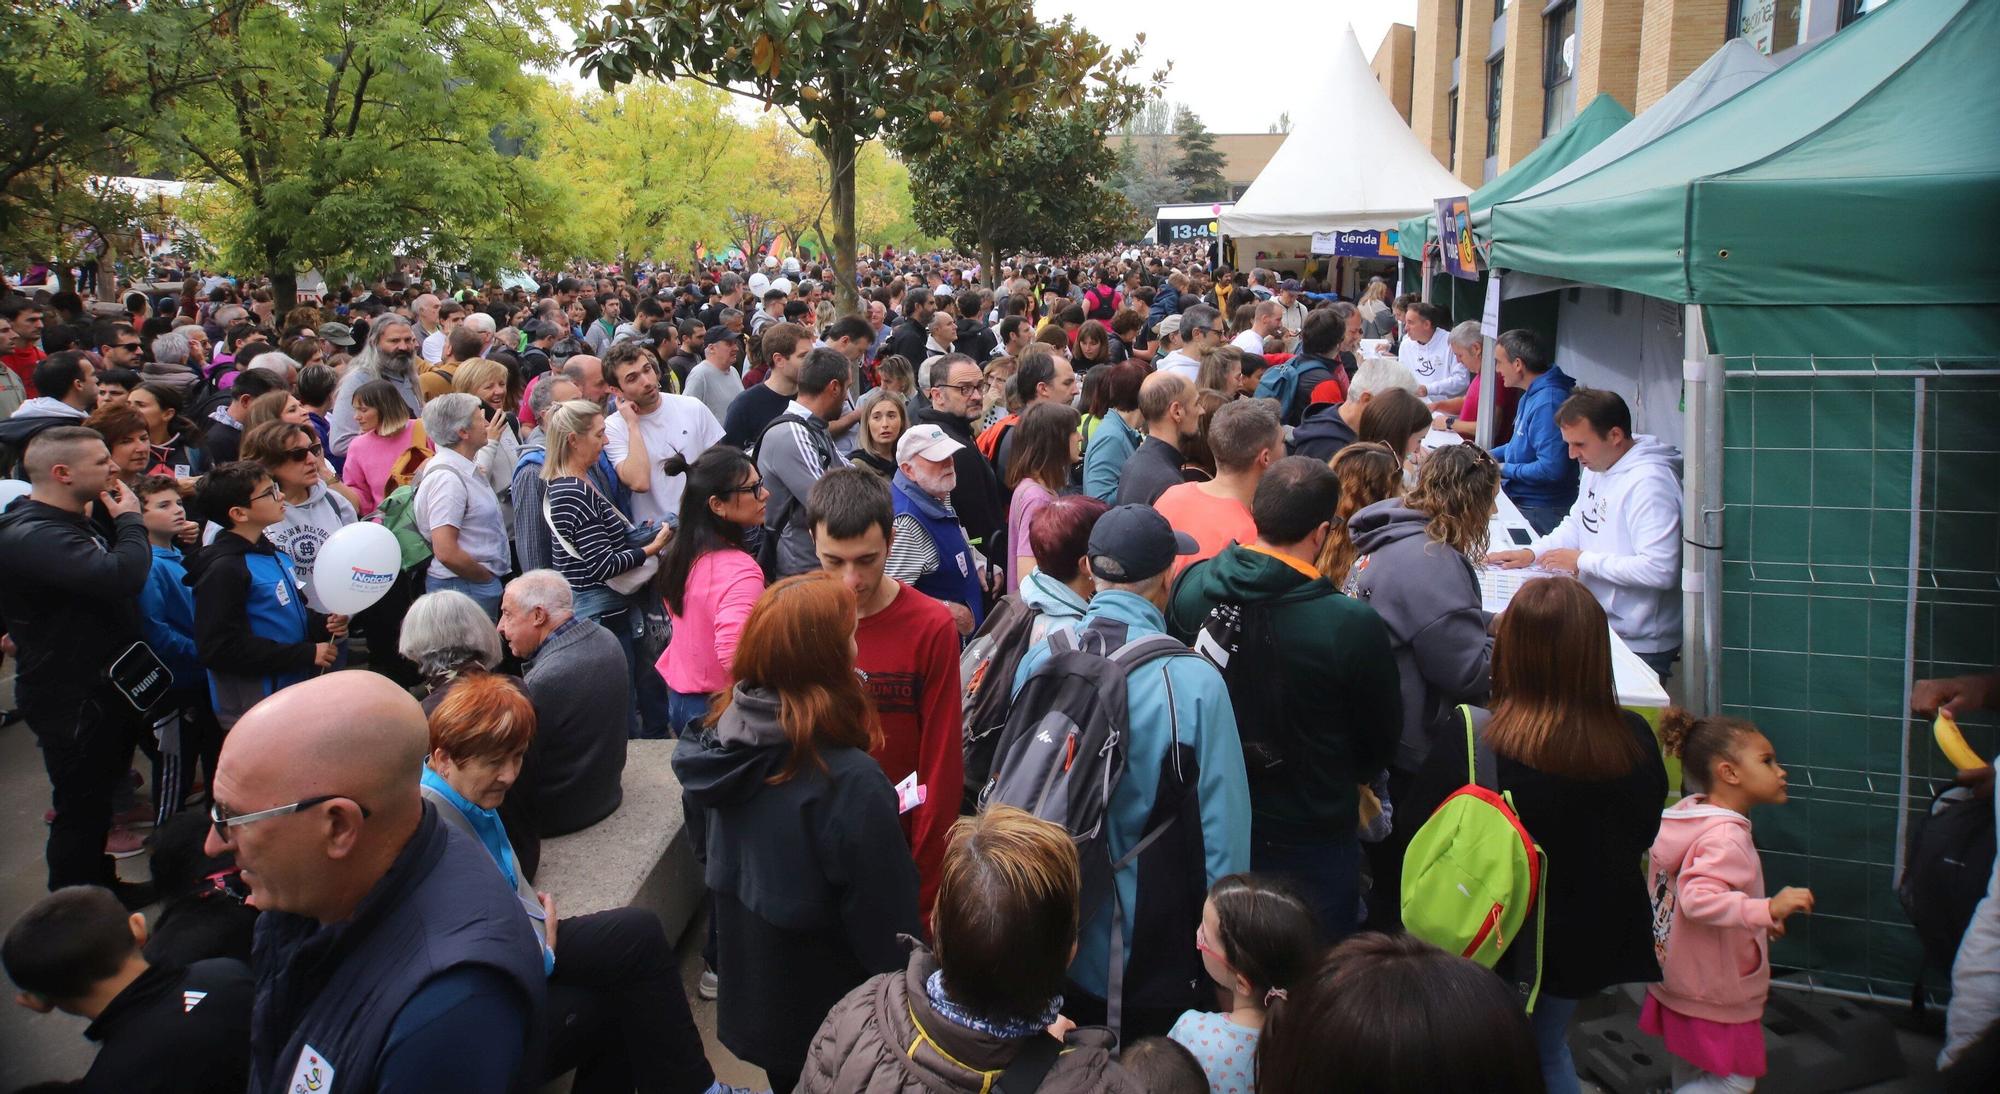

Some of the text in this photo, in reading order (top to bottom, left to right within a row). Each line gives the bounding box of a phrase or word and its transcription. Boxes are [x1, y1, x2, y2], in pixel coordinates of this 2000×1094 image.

[1171, 224, 1218, 239] 13:4
[1341, 233, 1377, 245] denda
[354, 571, 391, 584] Noticias
[131, 668, 159, 697] PUMA
